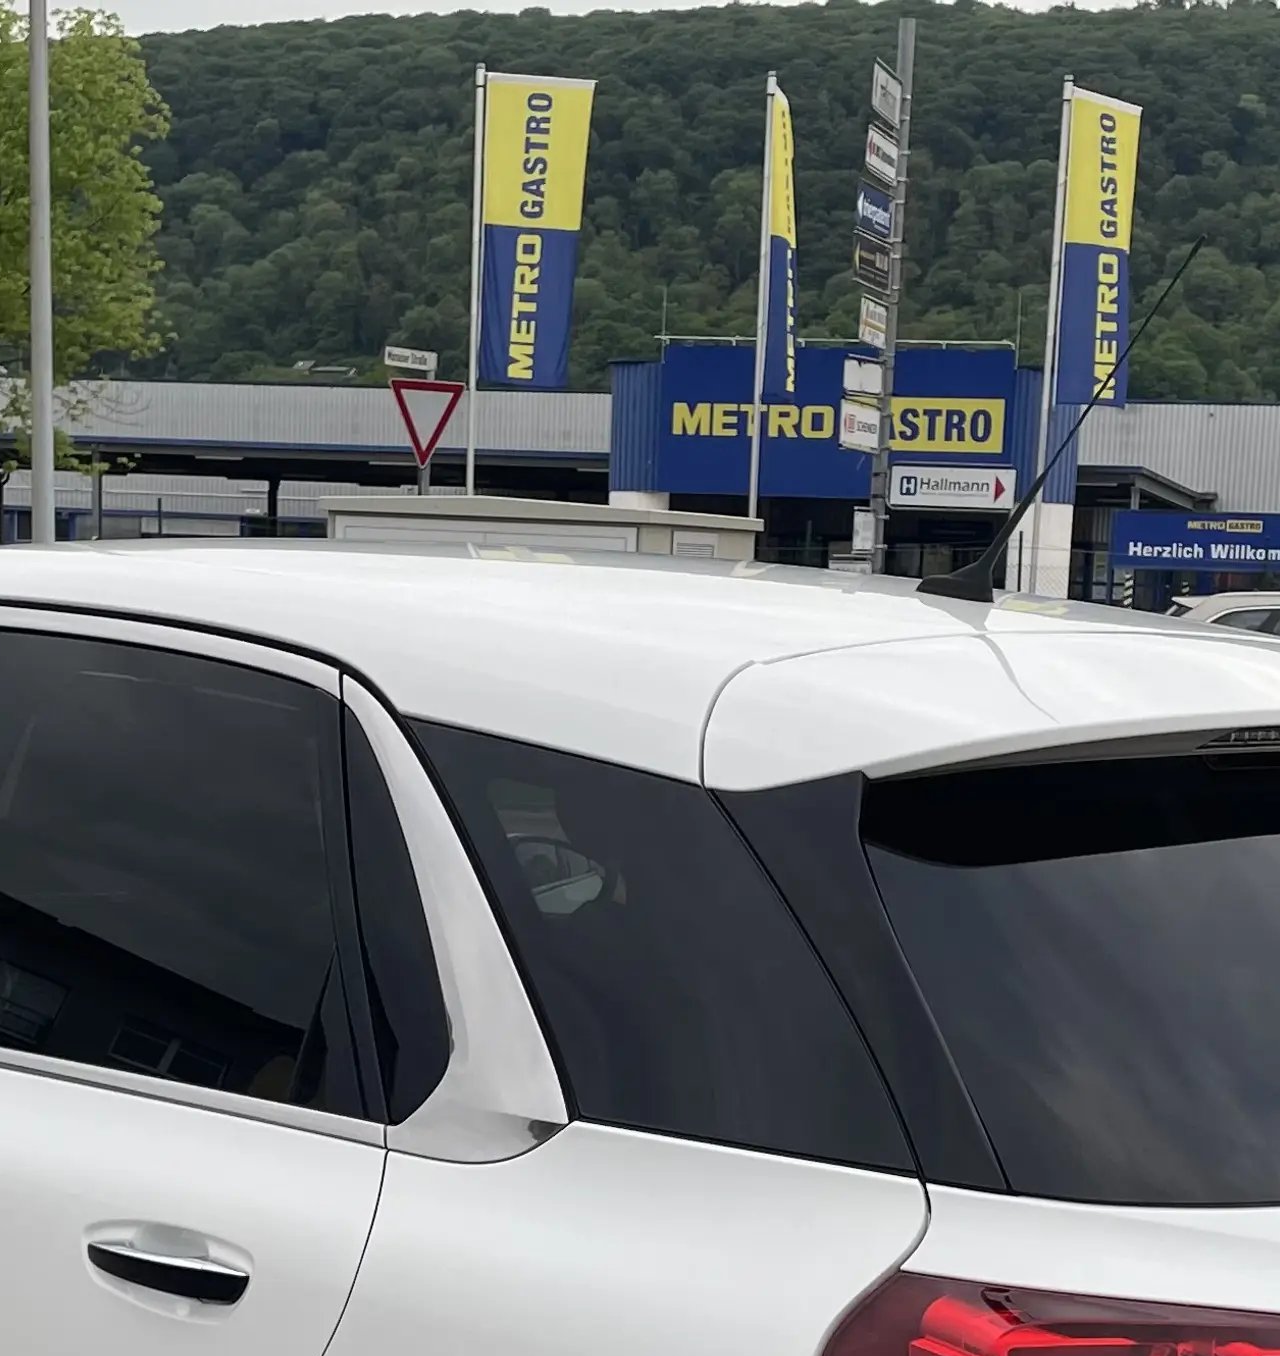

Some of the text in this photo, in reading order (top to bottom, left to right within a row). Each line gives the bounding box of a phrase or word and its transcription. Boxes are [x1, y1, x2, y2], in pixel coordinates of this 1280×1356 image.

[507, 92, 553, 380] METRO GASTRO
[1093, 112, 1119, 400] METRO GASTRO
[672, 402, 992, 443] METRO STRO
[920, 477, 990, 493] Hallmann
[1187, 520, 1262, 532] METRO GASTRO
[1129, 541, 1204, 559] Herzlich
